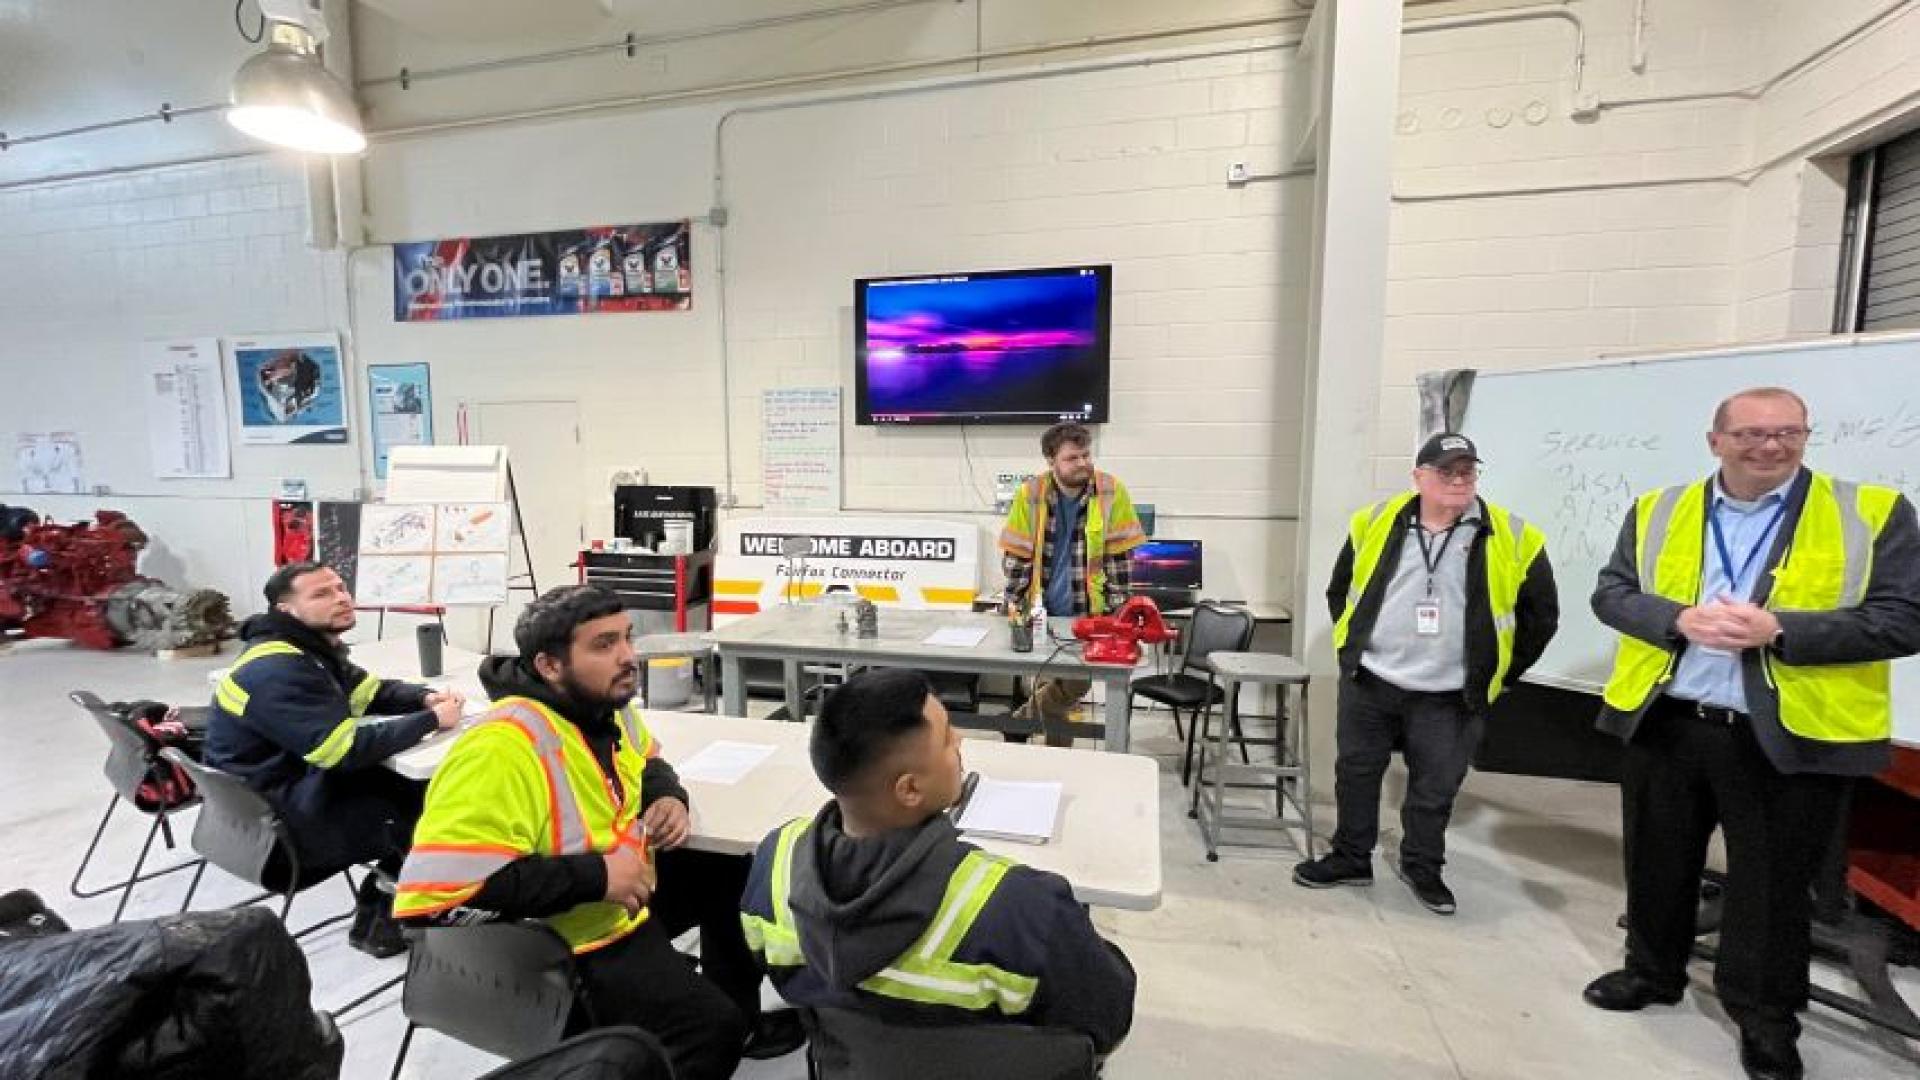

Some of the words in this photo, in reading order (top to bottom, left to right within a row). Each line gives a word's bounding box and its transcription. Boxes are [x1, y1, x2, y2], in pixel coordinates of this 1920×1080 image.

[406, 263, 478, 296] ONLY
[859, 539, 953, 559] ABOARD
[832, 566, 907, 580] Connector
